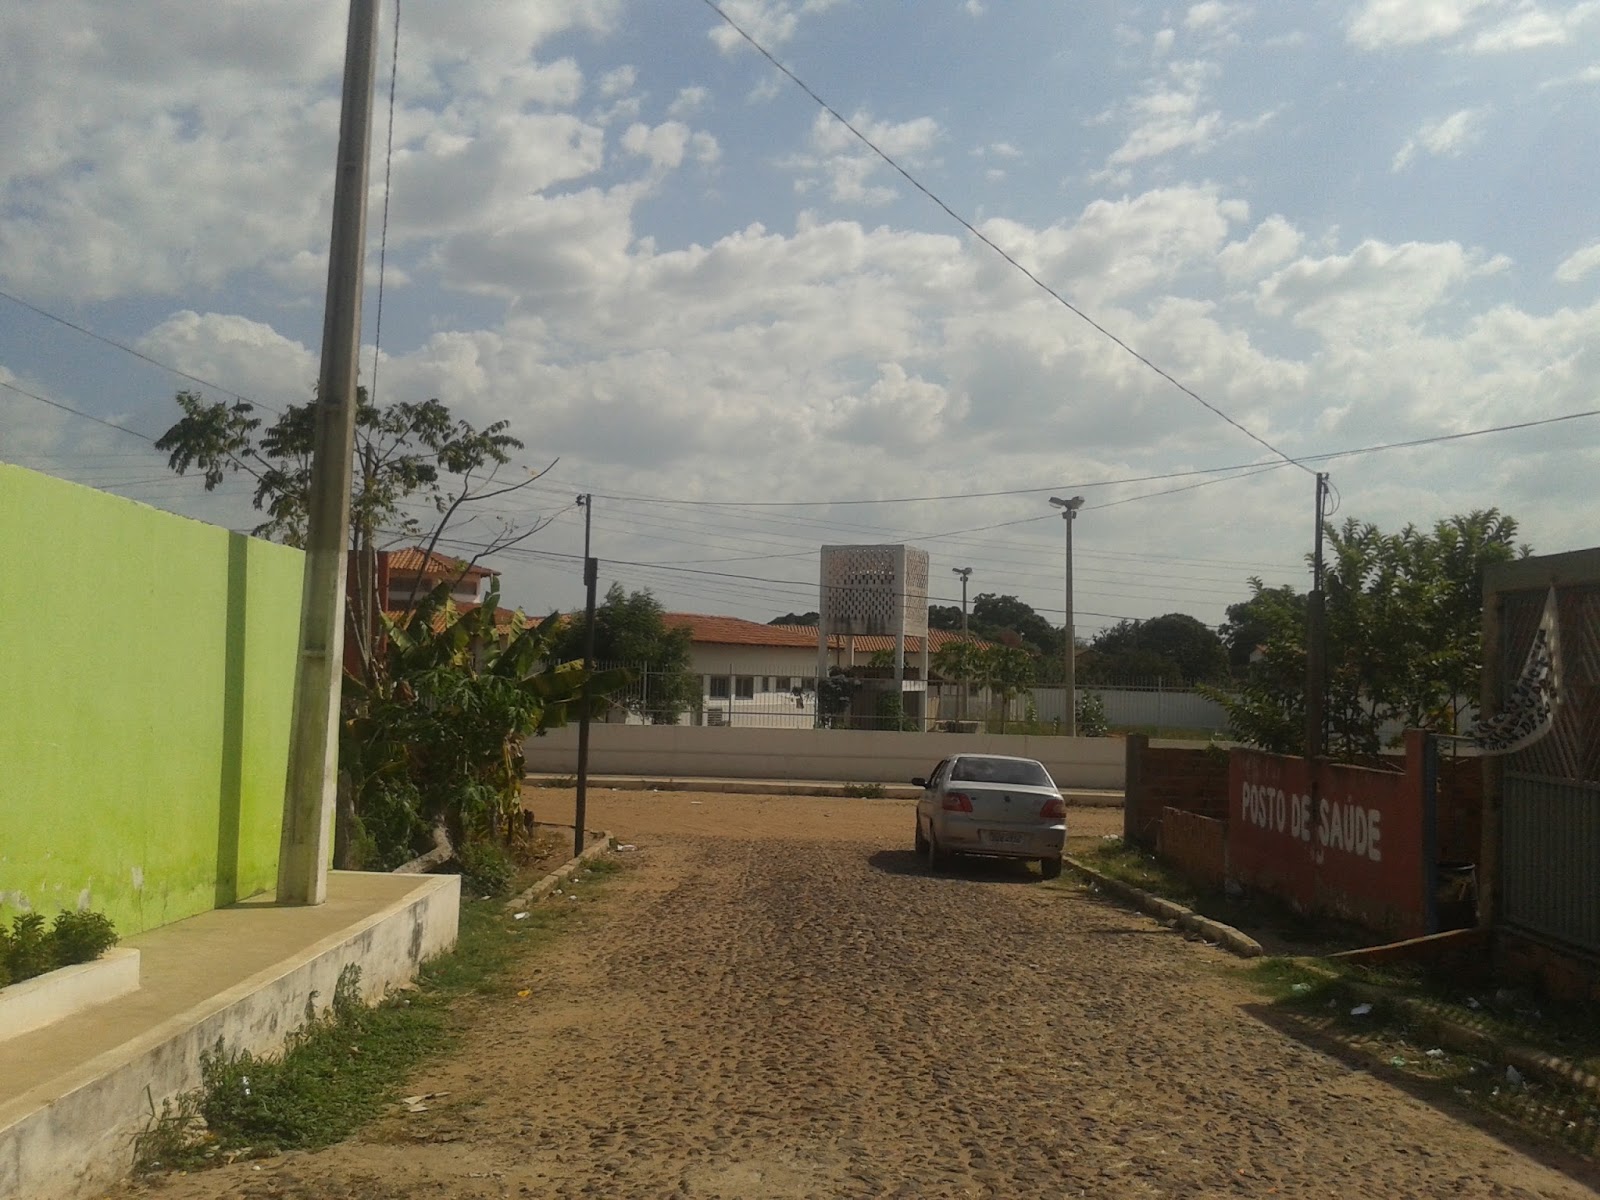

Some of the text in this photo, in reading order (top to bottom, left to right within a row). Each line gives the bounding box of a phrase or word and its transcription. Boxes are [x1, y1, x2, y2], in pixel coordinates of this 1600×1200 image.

[1242, 781, 1381, 862] POSTO DE SAÚDE
